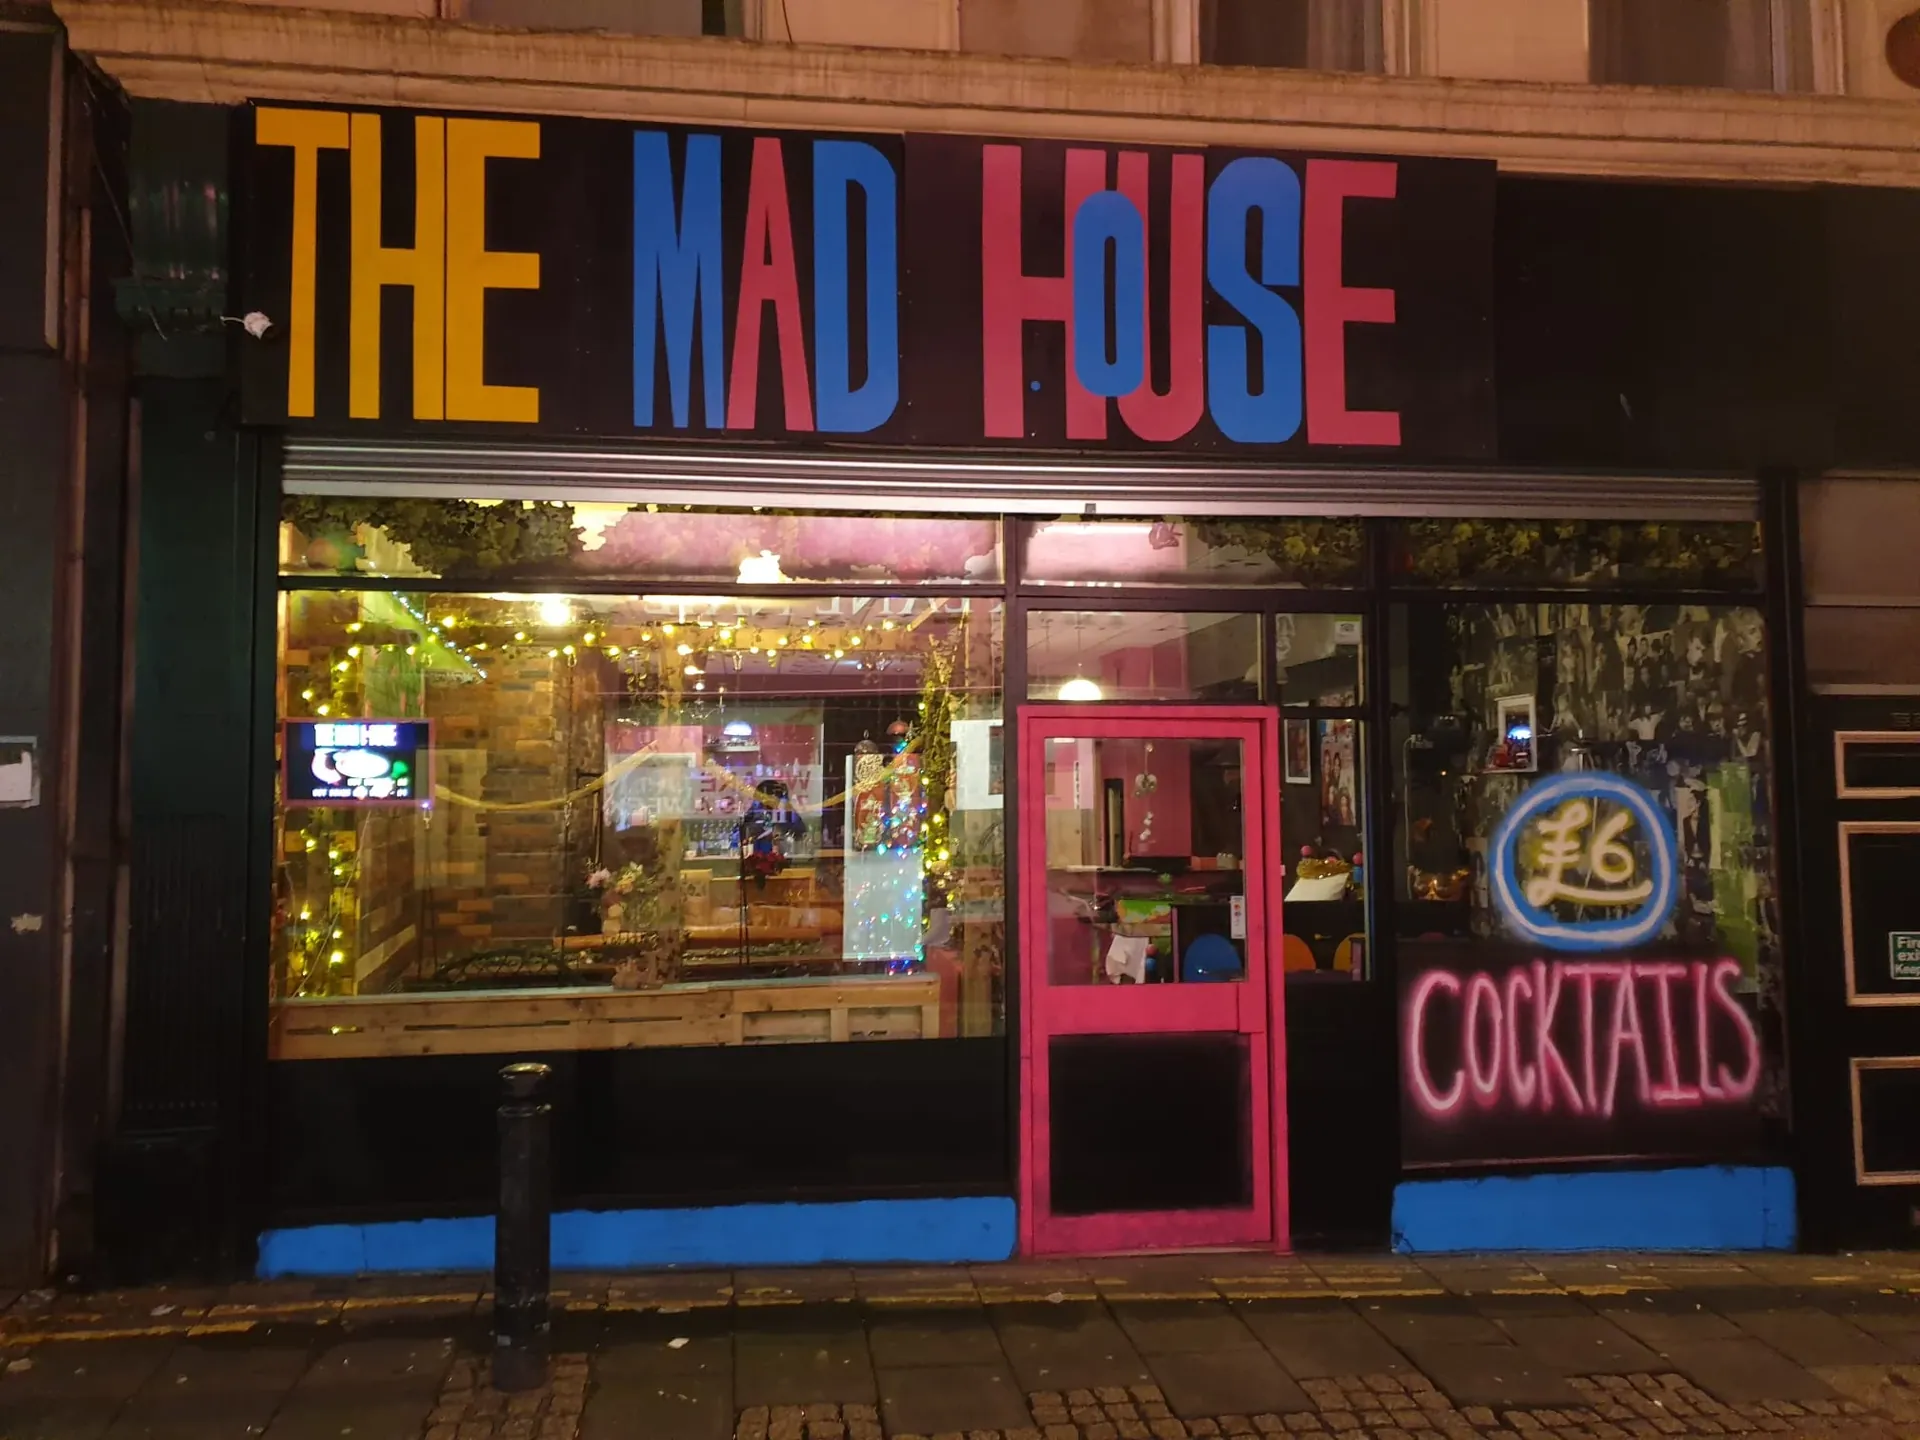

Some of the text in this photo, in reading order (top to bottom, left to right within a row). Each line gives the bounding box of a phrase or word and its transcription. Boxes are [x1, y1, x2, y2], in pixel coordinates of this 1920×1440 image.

[256, 107, 1402, 446] THE MAD HOUSE
[1526, 800, 1654, 907] £6
[1897, 949, 1920, 962] exi
[1409, 958, 1761, 1117] COCKTAILS
